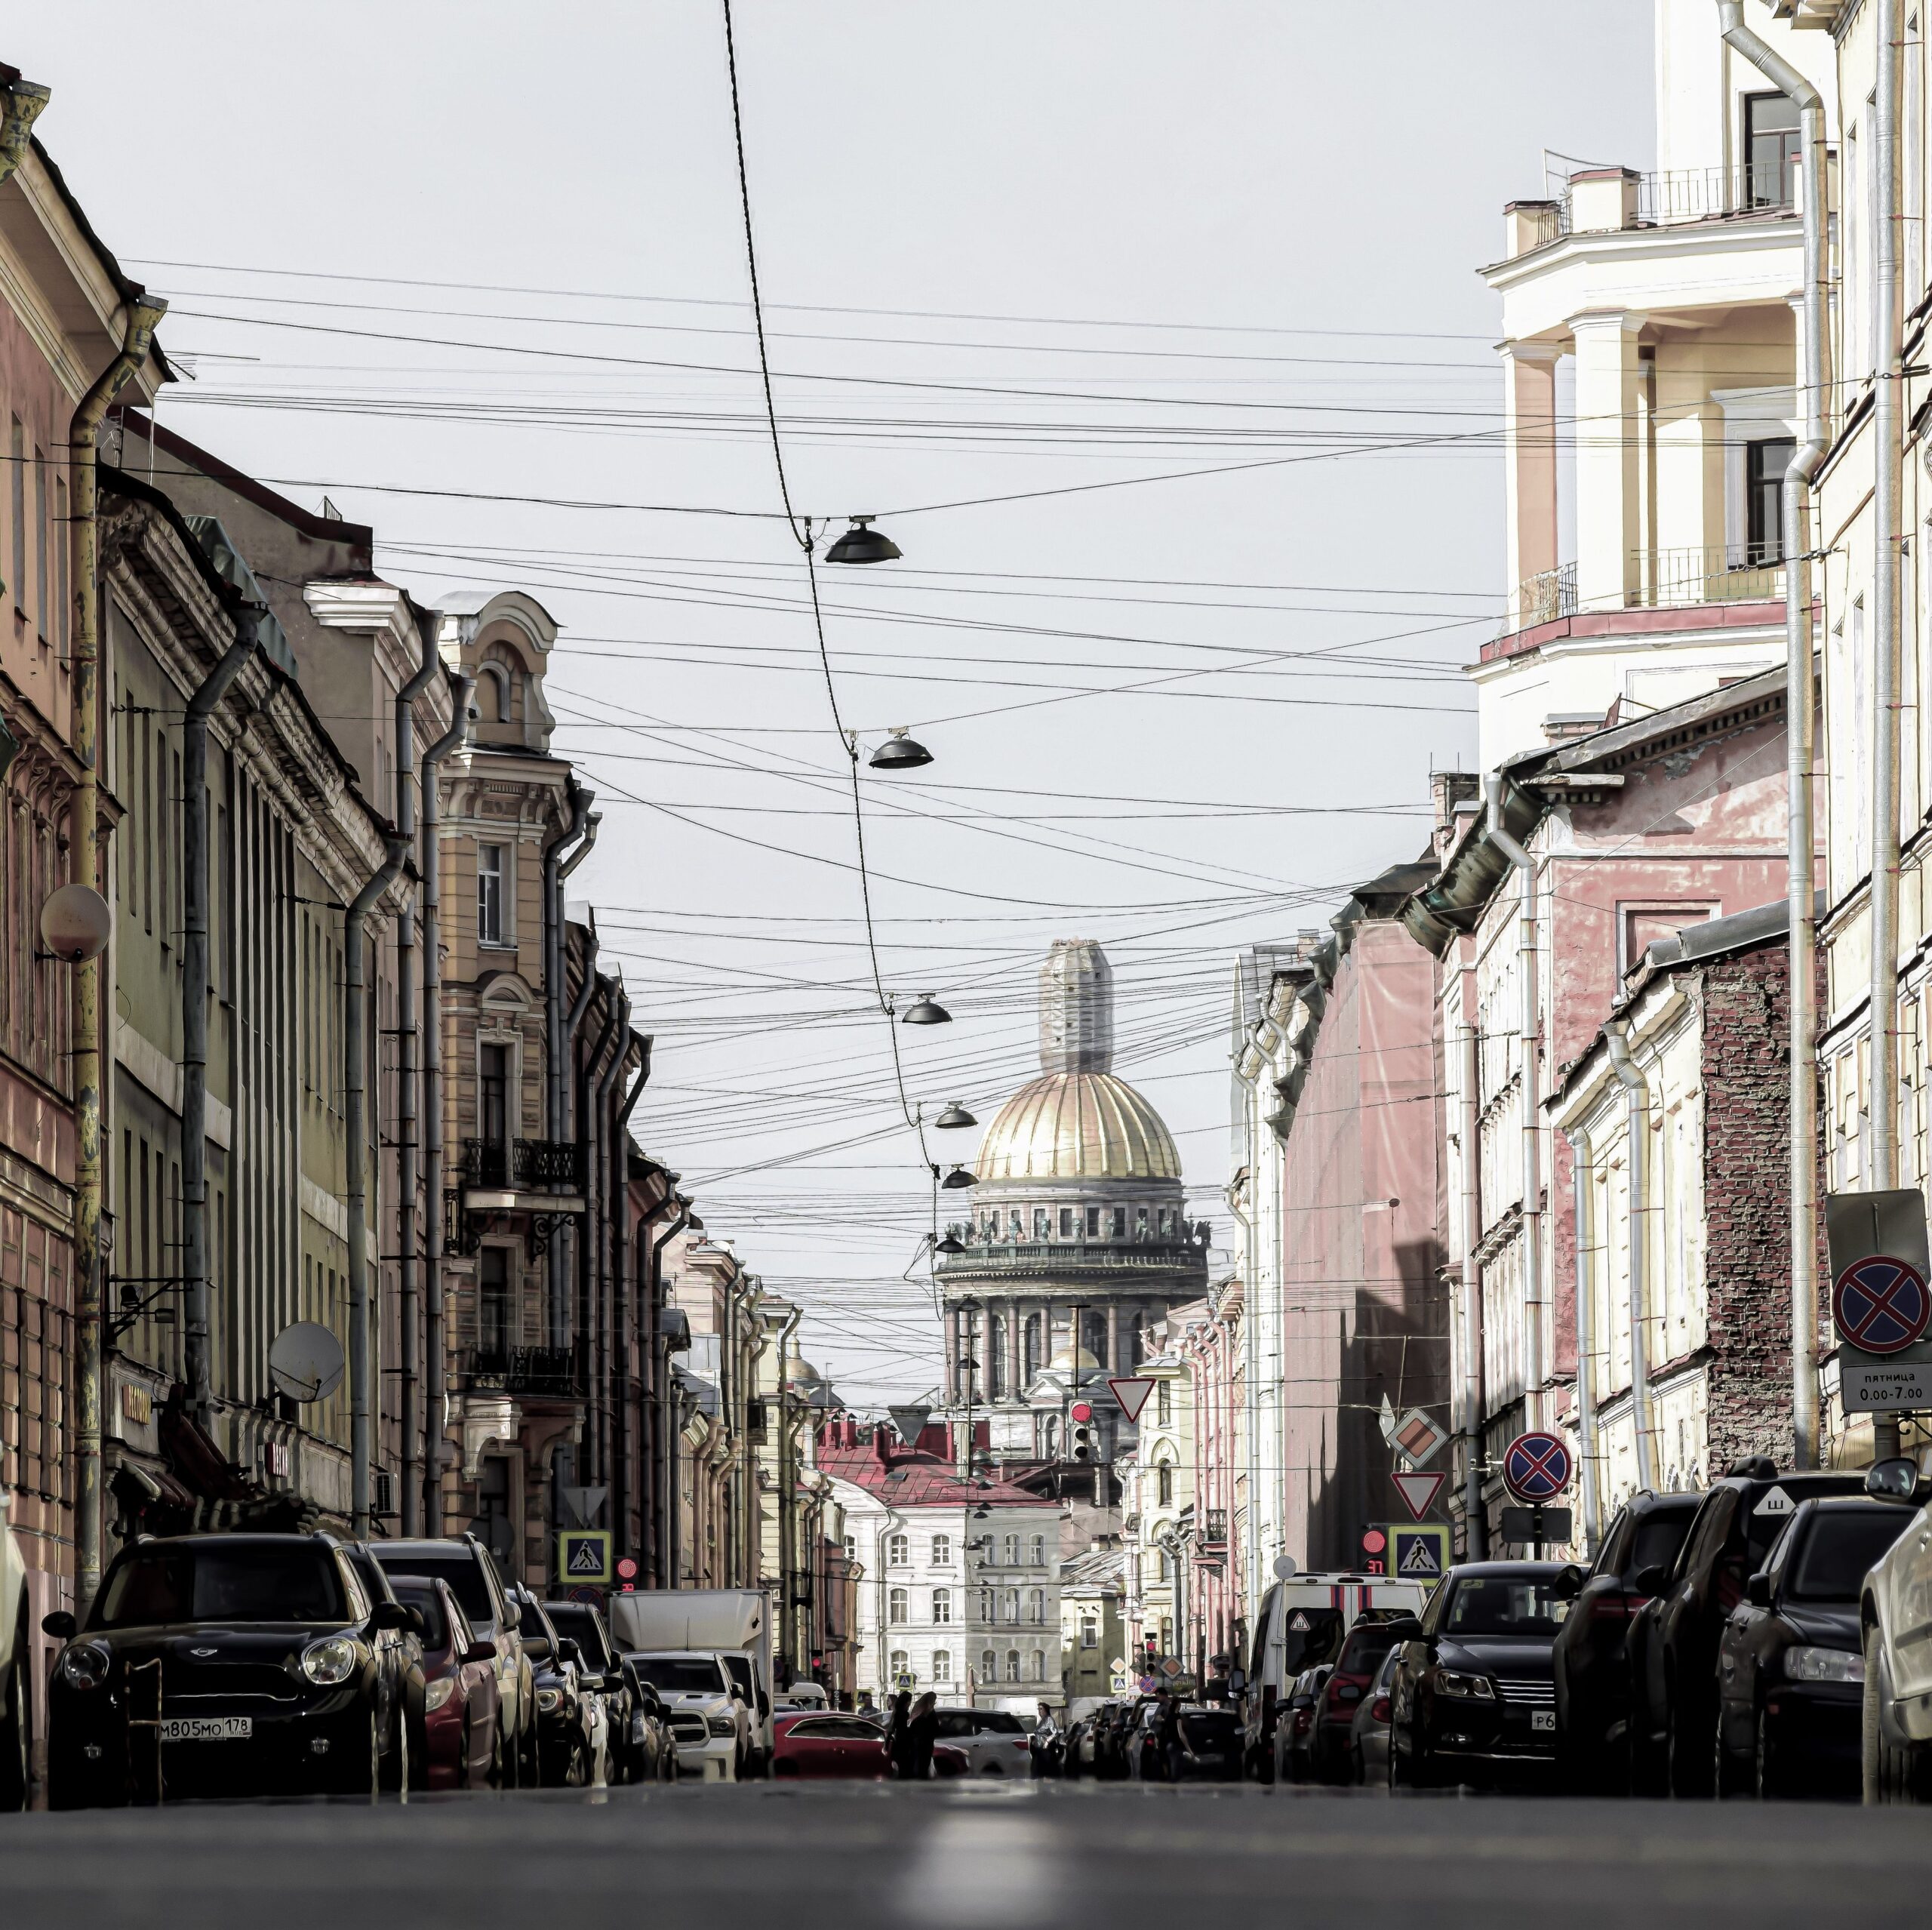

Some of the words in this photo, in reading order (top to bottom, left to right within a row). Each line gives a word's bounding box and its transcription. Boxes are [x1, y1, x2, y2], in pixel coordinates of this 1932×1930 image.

[1865, 1374, 1915, 1383] пятница
[1860, 1387, 1923, 1401] 0.00-7.00
[1767, 1500, 1783, 1510] Ш
